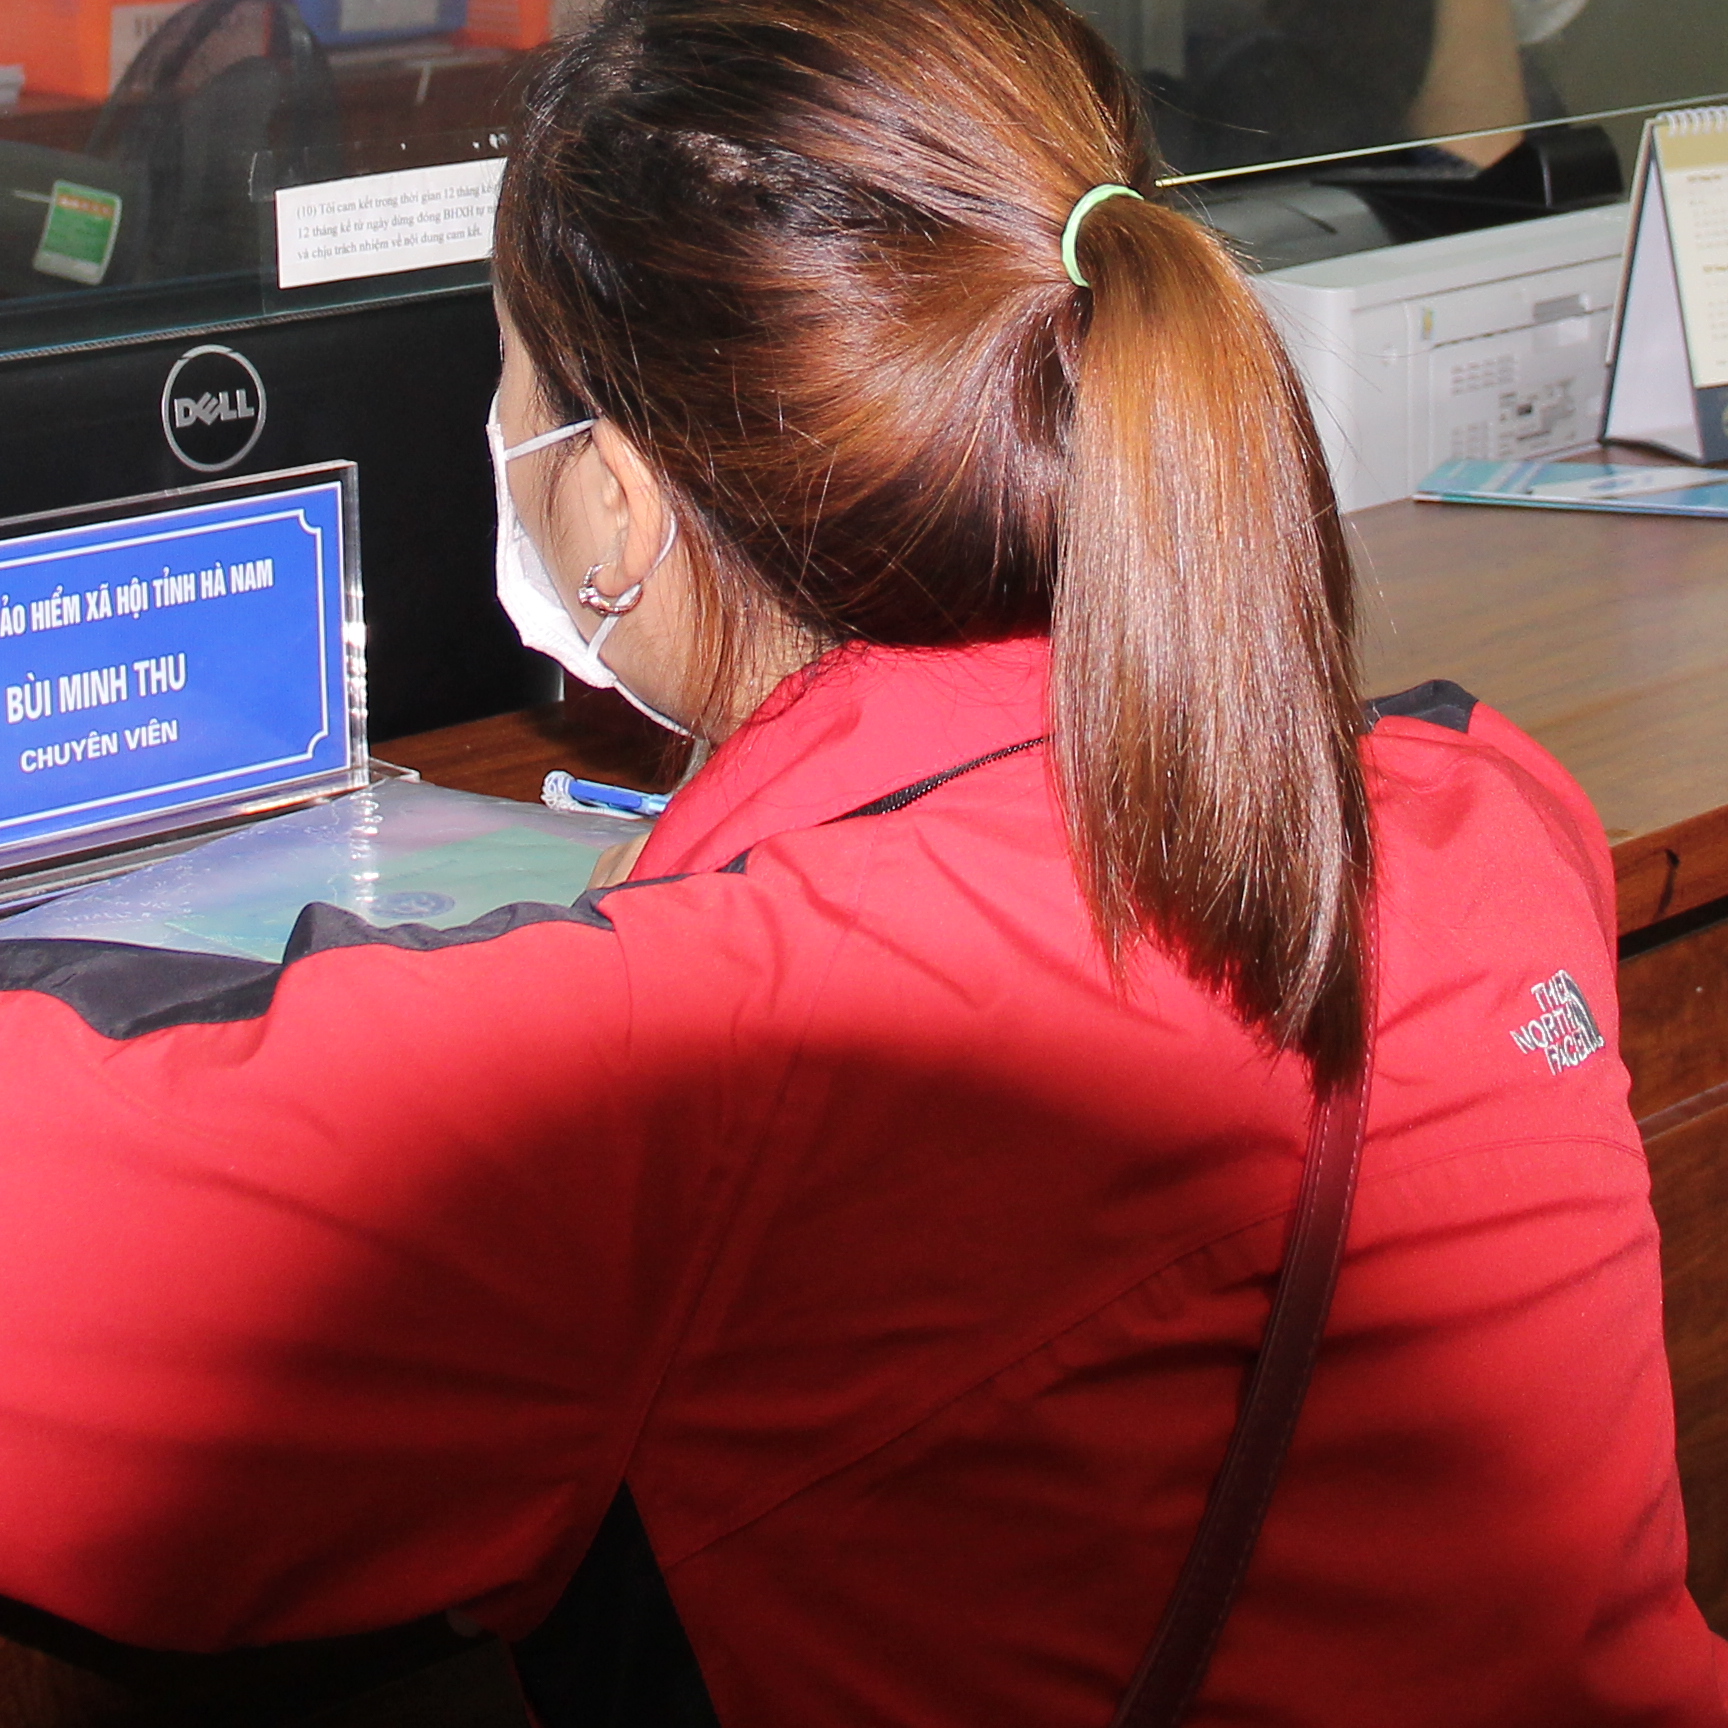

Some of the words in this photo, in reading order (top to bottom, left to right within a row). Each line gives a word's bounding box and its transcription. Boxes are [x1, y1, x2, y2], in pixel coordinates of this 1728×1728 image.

[297, 203, 317, 220] (10)
[319, 200, 336, 215] Tôi
[337, 201, 356, 213] cam
[375, 194, 398, 210] trong
[421, 189, 442, 205] gian
[443, 187, 455, 200] 12
[298, 227, 310, 240] 12
[366, 217, 389, 234] ngày
[443, 205, 474, 221] BHXH
[359, 237, 389, 255] nhiệm
[420, 230, 444, 247] dung
[446, 229, 466, 242] cam
[173, 388, 255, 428] DELL
[30, 584, 82, 632] HIỂM
[85, 581, 112, 622] XÃ
[115, 576, 149, 619] HỘI
[152, 565, 196, 609] TỈNH
[200, 561, 226, 600] HÀ
[229, 557, 274, 595] NAM
[5, 671, 52, 724] BÙI
[58, 663, 128, 714] MINH
[133, 651, 188, 698] THU
[20, 730, 118, 773] CHUYÊN
[124, 717, 179, 751] VIÊN
[1530, 969, 1571, 1013] THE
[1509, 1001, 1583, 1055] NORTH
[1544, 1028, 1591, 1076] FACE
